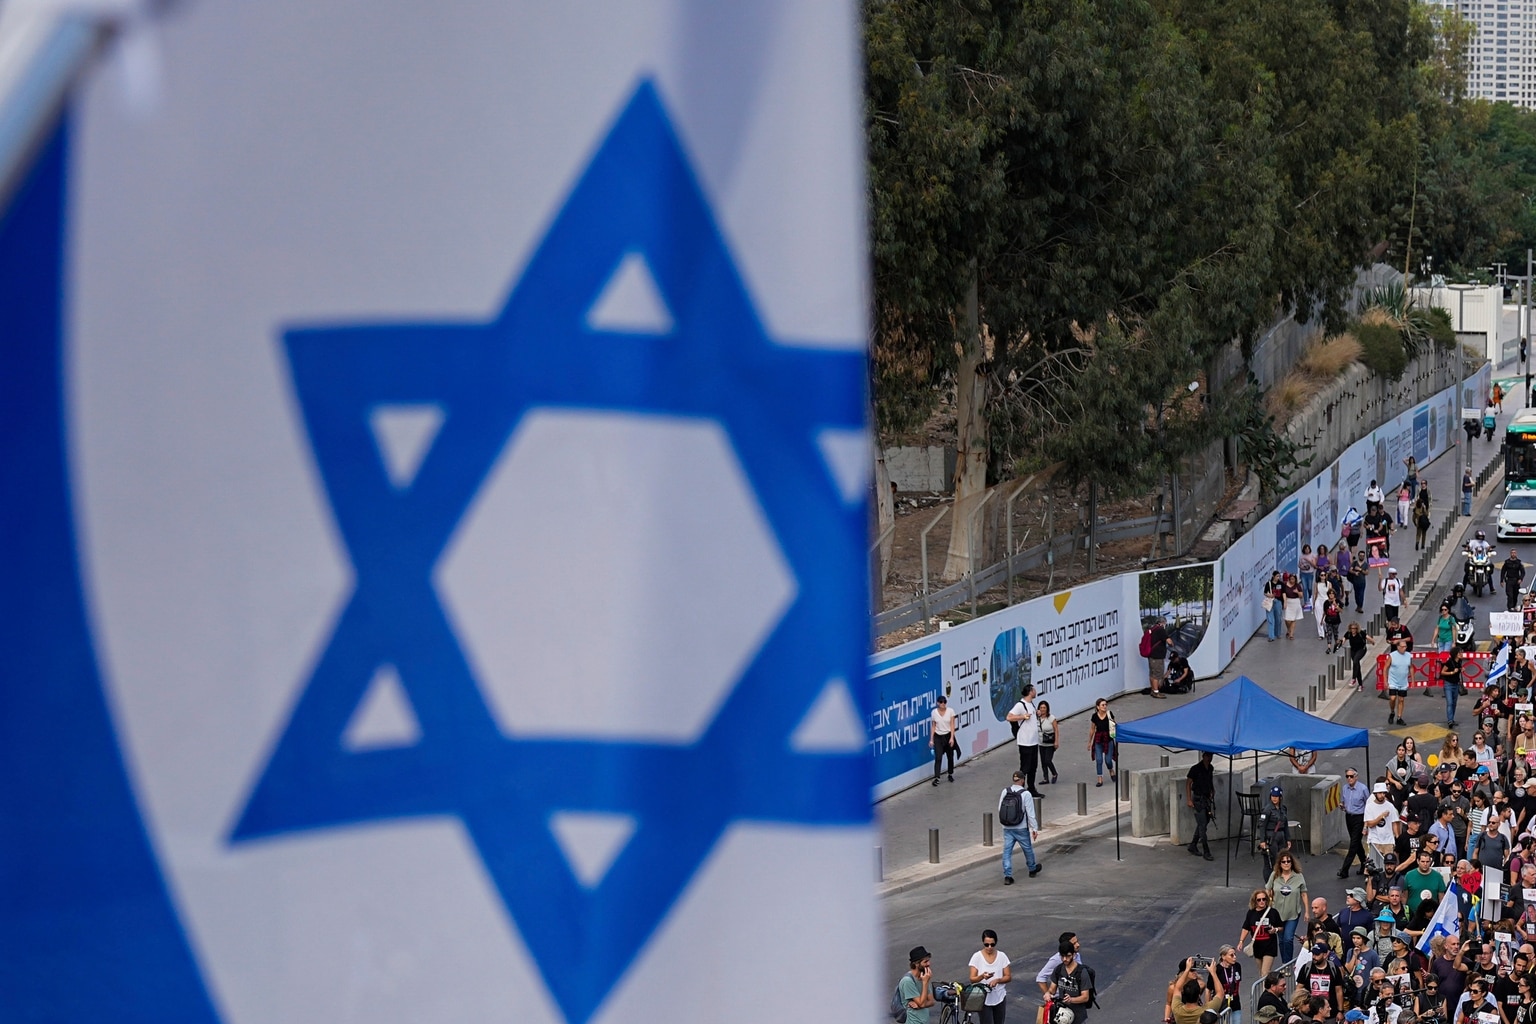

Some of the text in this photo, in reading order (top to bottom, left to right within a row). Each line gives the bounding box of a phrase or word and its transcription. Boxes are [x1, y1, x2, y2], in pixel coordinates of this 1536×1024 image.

[1036, 609, 1118, 648] חידוש המרחב הציבורי
[1091, 631, 1119, 653] בכניסה
[951, 656, 980, 680] מעברי
[1050, 647, 1074, 669] תחנות
[1036, 653, 1119, 697] הרכבת הקלה ברחוב
[910, 689, 937, 716] עיריית
[960, 681, 980, 705] חציה
[885, 729, 901, 752] את
[903, 716, 933, 746] חדשת
[1462, 876, 1481, 885] NOW
